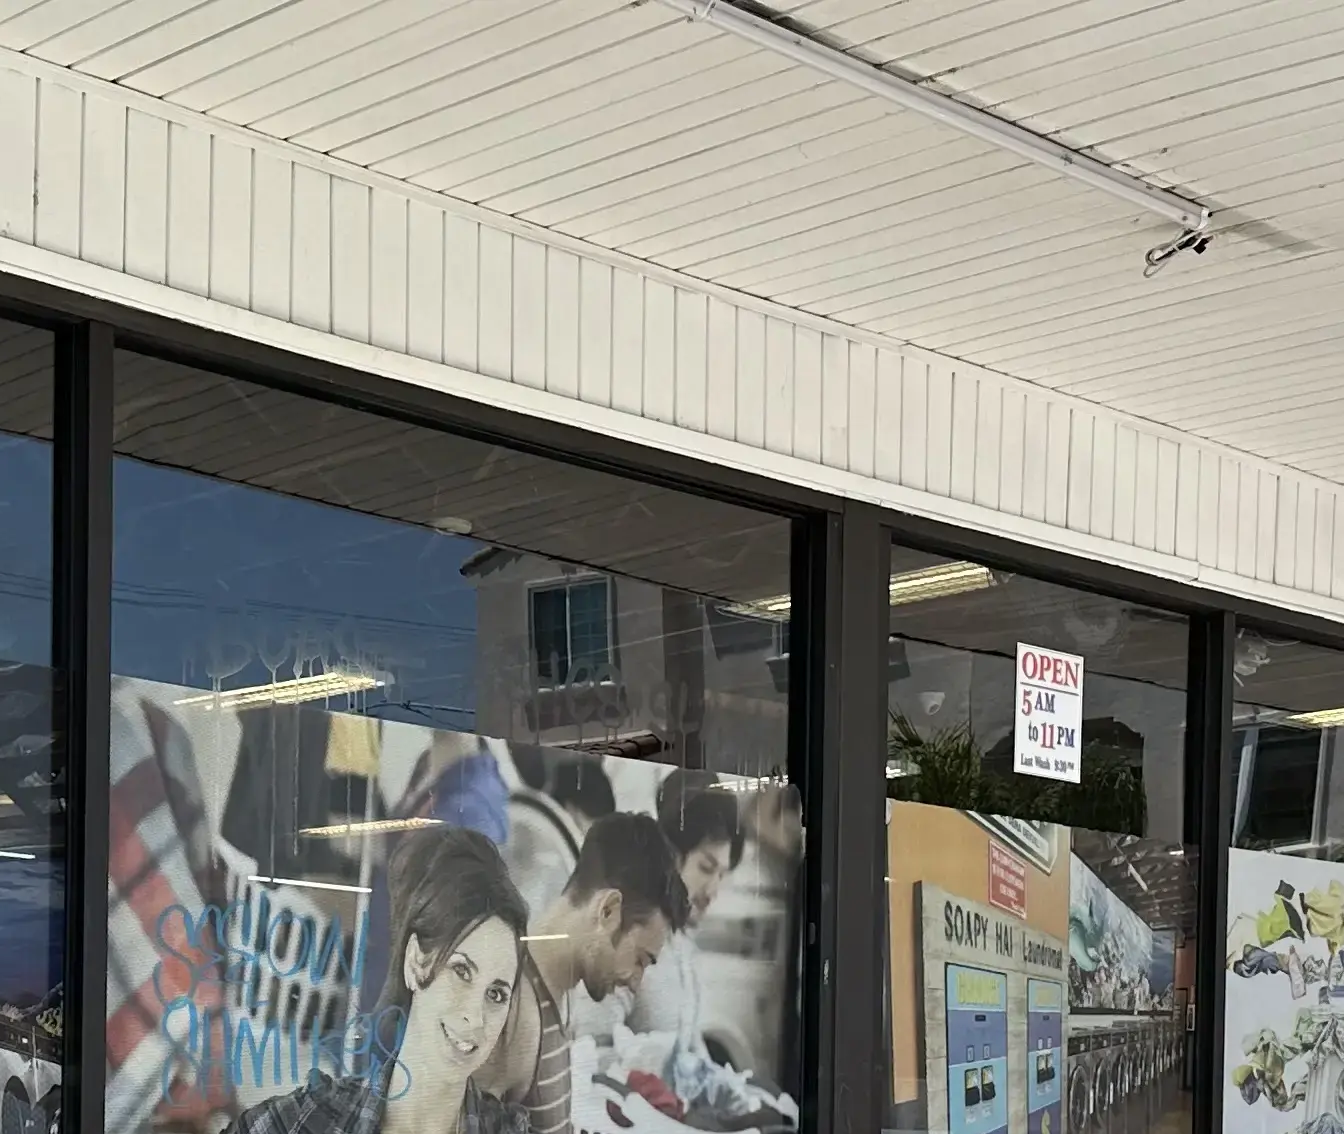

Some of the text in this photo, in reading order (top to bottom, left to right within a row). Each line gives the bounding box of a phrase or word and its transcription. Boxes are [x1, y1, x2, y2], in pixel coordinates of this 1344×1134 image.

[1021, 651, 1080, 690] OPEN
[1021, 688, 1056, 717] 5 AM
[1027, 720, 1076, 750] to 11 PM
[944, 900, 988, 951] SOAPY
[995, 920, 1013, 958] HAI
